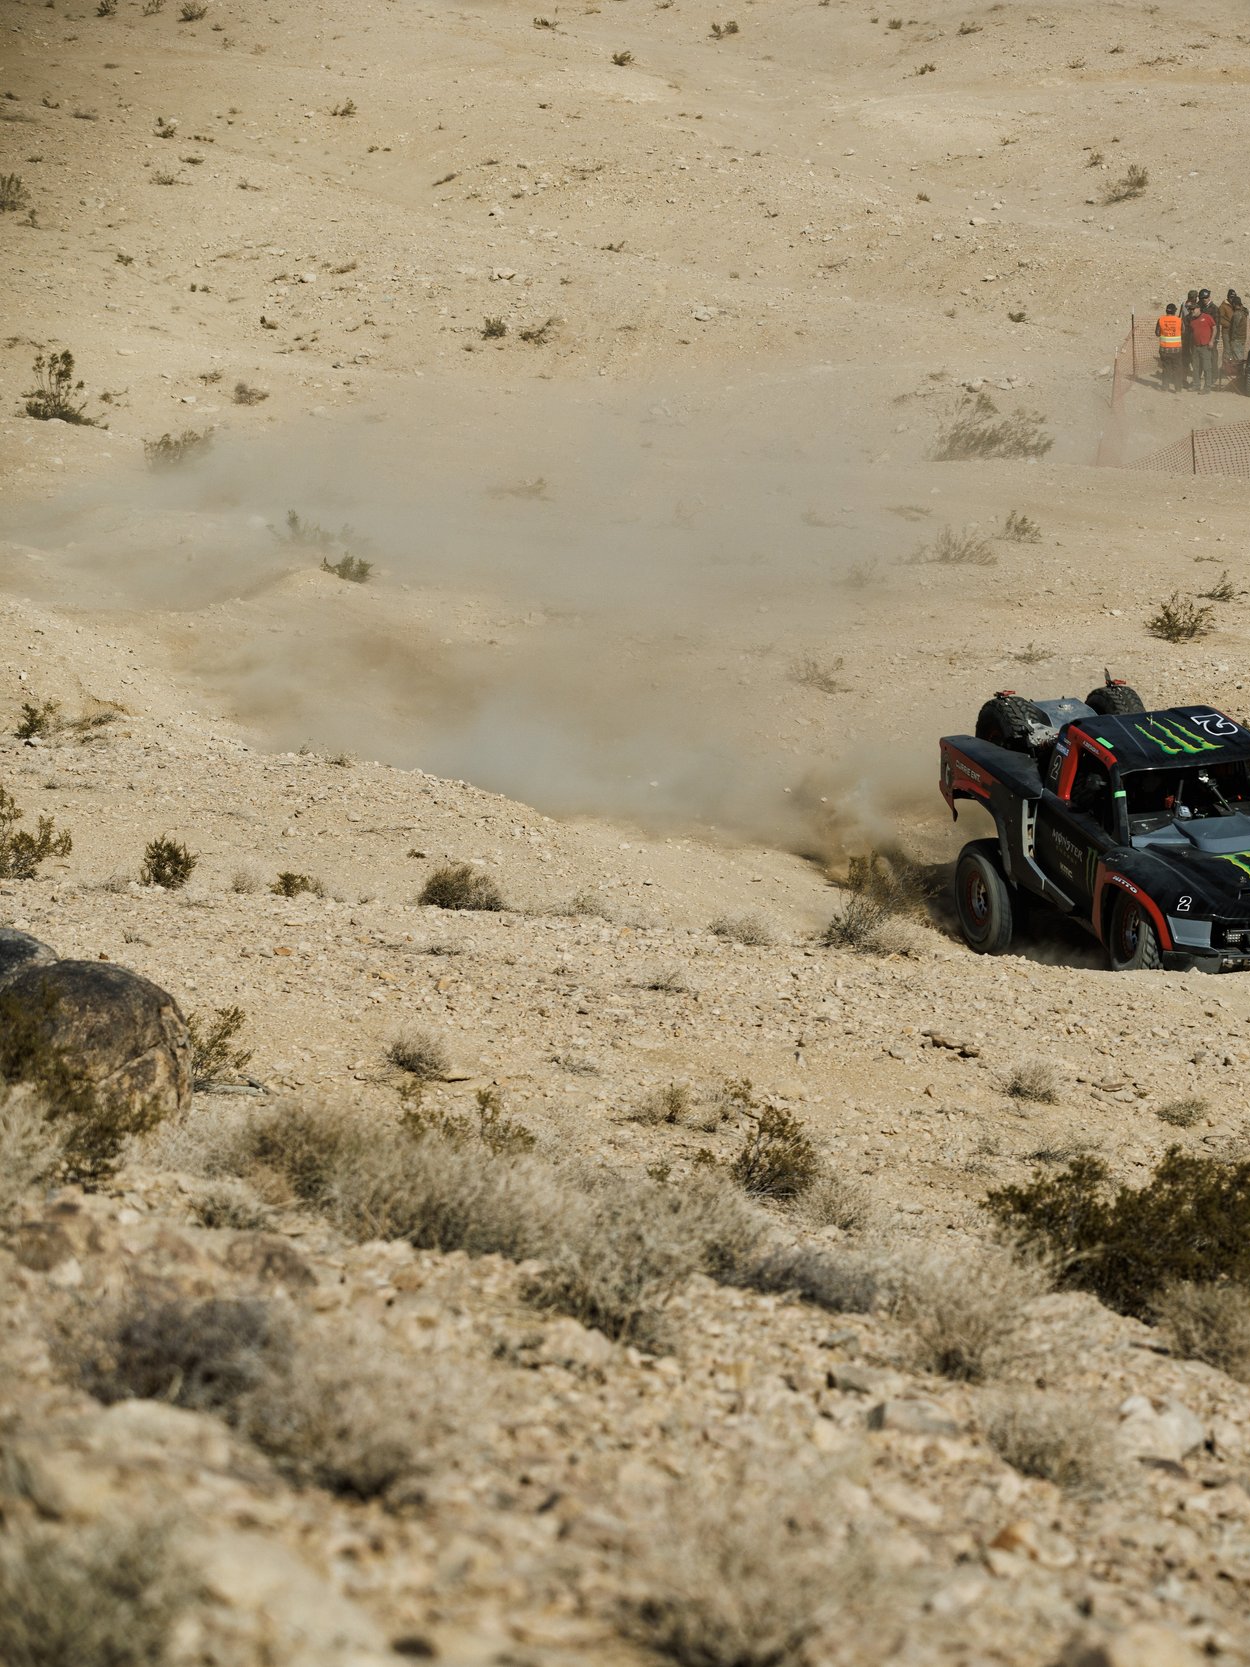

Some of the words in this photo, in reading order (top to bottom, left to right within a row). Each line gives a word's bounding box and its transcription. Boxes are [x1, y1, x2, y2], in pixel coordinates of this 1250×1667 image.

[1190, 713, 1239, 736] 2
[1050, 754, 1063, 780] 2
[1052, 828, 1084, 863] MONSTER
[1112, 874, 1138, 894] NITTO
[1176, 895, 1193, 912] 2
